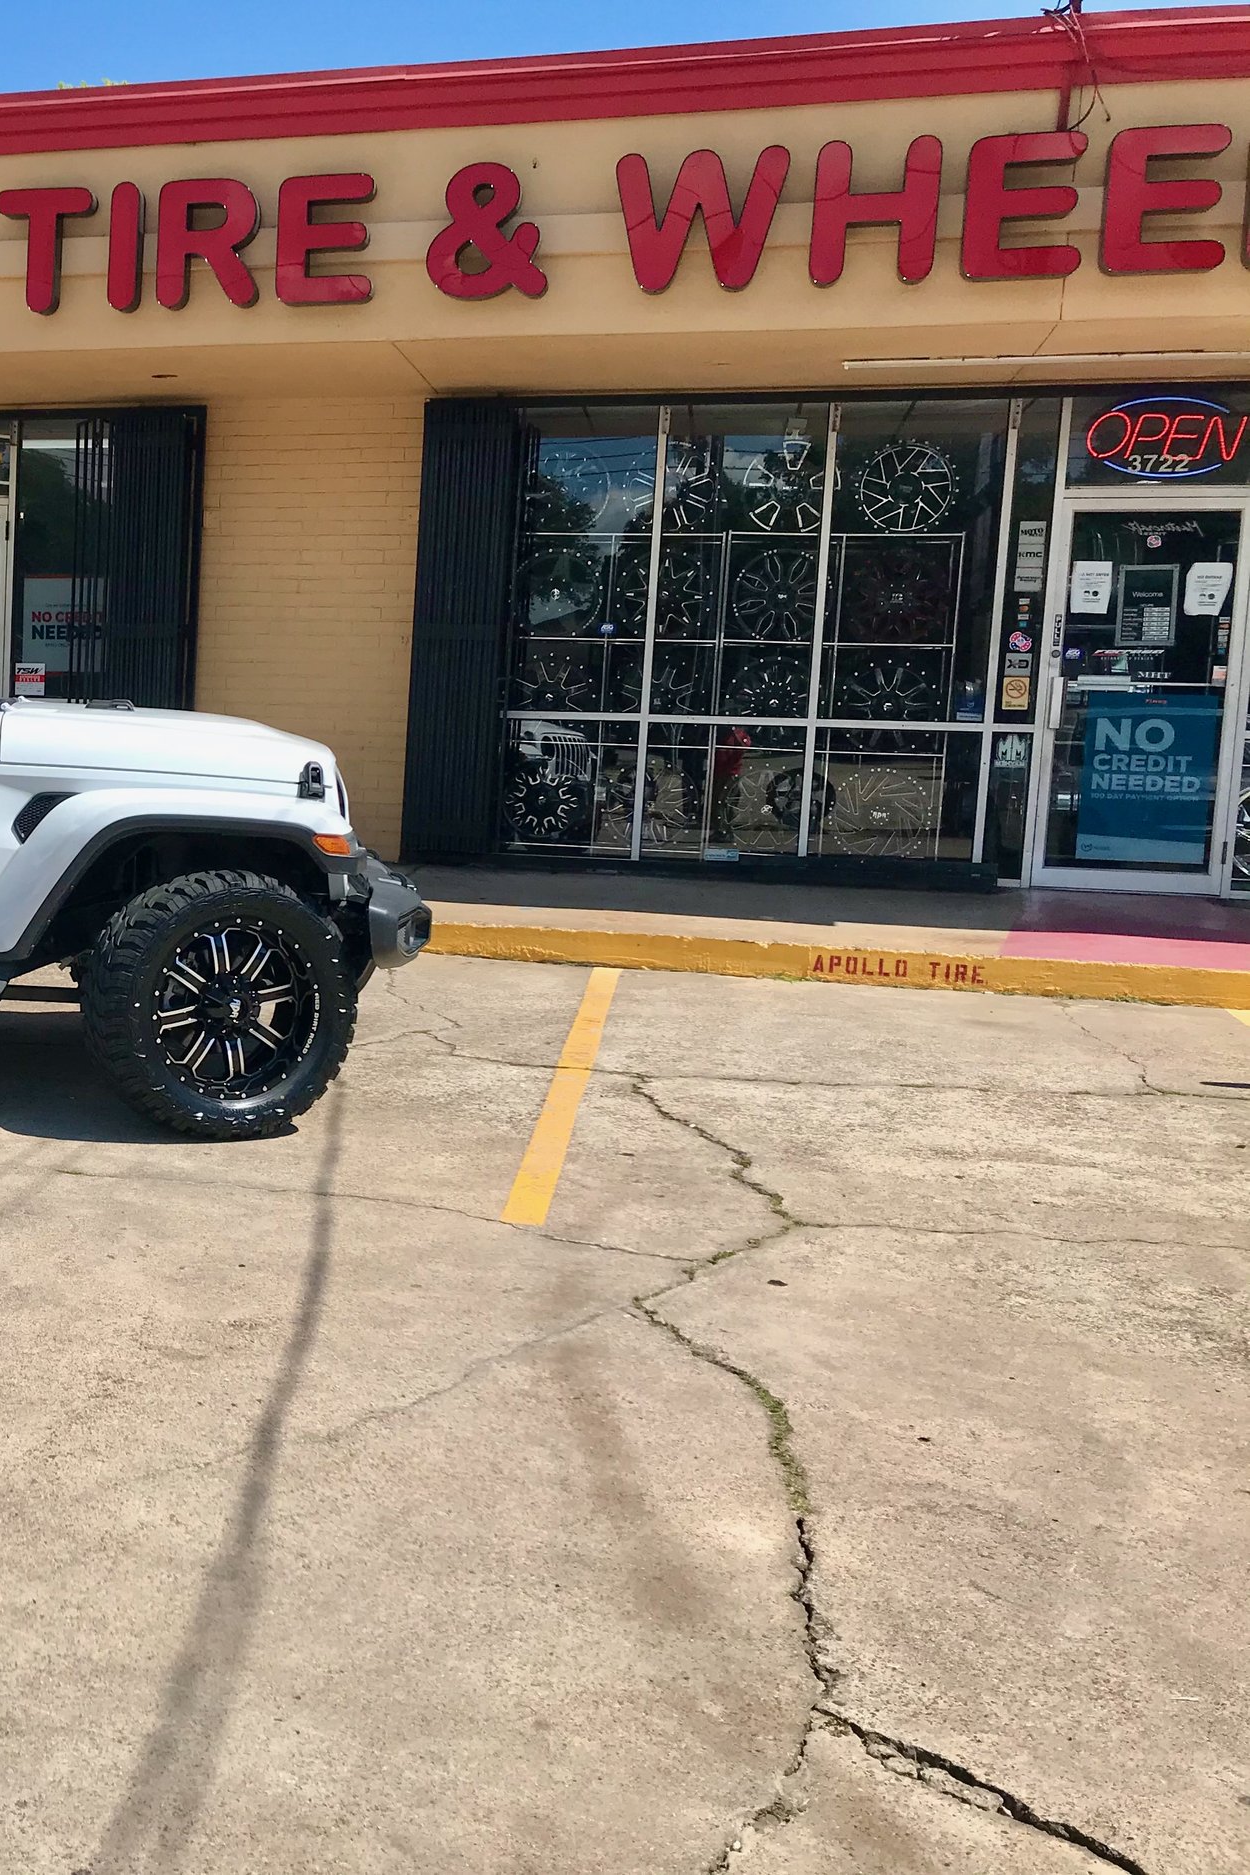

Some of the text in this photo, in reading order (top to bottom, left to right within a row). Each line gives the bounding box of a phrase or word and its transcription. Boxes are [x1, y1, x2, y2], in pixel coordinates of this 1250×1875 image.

[425, 161, 548, 301] &
[616, 123, 1250, 295] WHEE
[1086, 411, 1248, 460] OPEN
[1128, 454, 1190, 473] 3722
[31, 611, 52, 622] NO
[1094, 718, 1175, 752] NO
[1093, 753, 1192, 773] CREDIT
[1091, 773, 1200, 793] NEEDED
[812, 955, 986, 984] APOLLO TIRE
